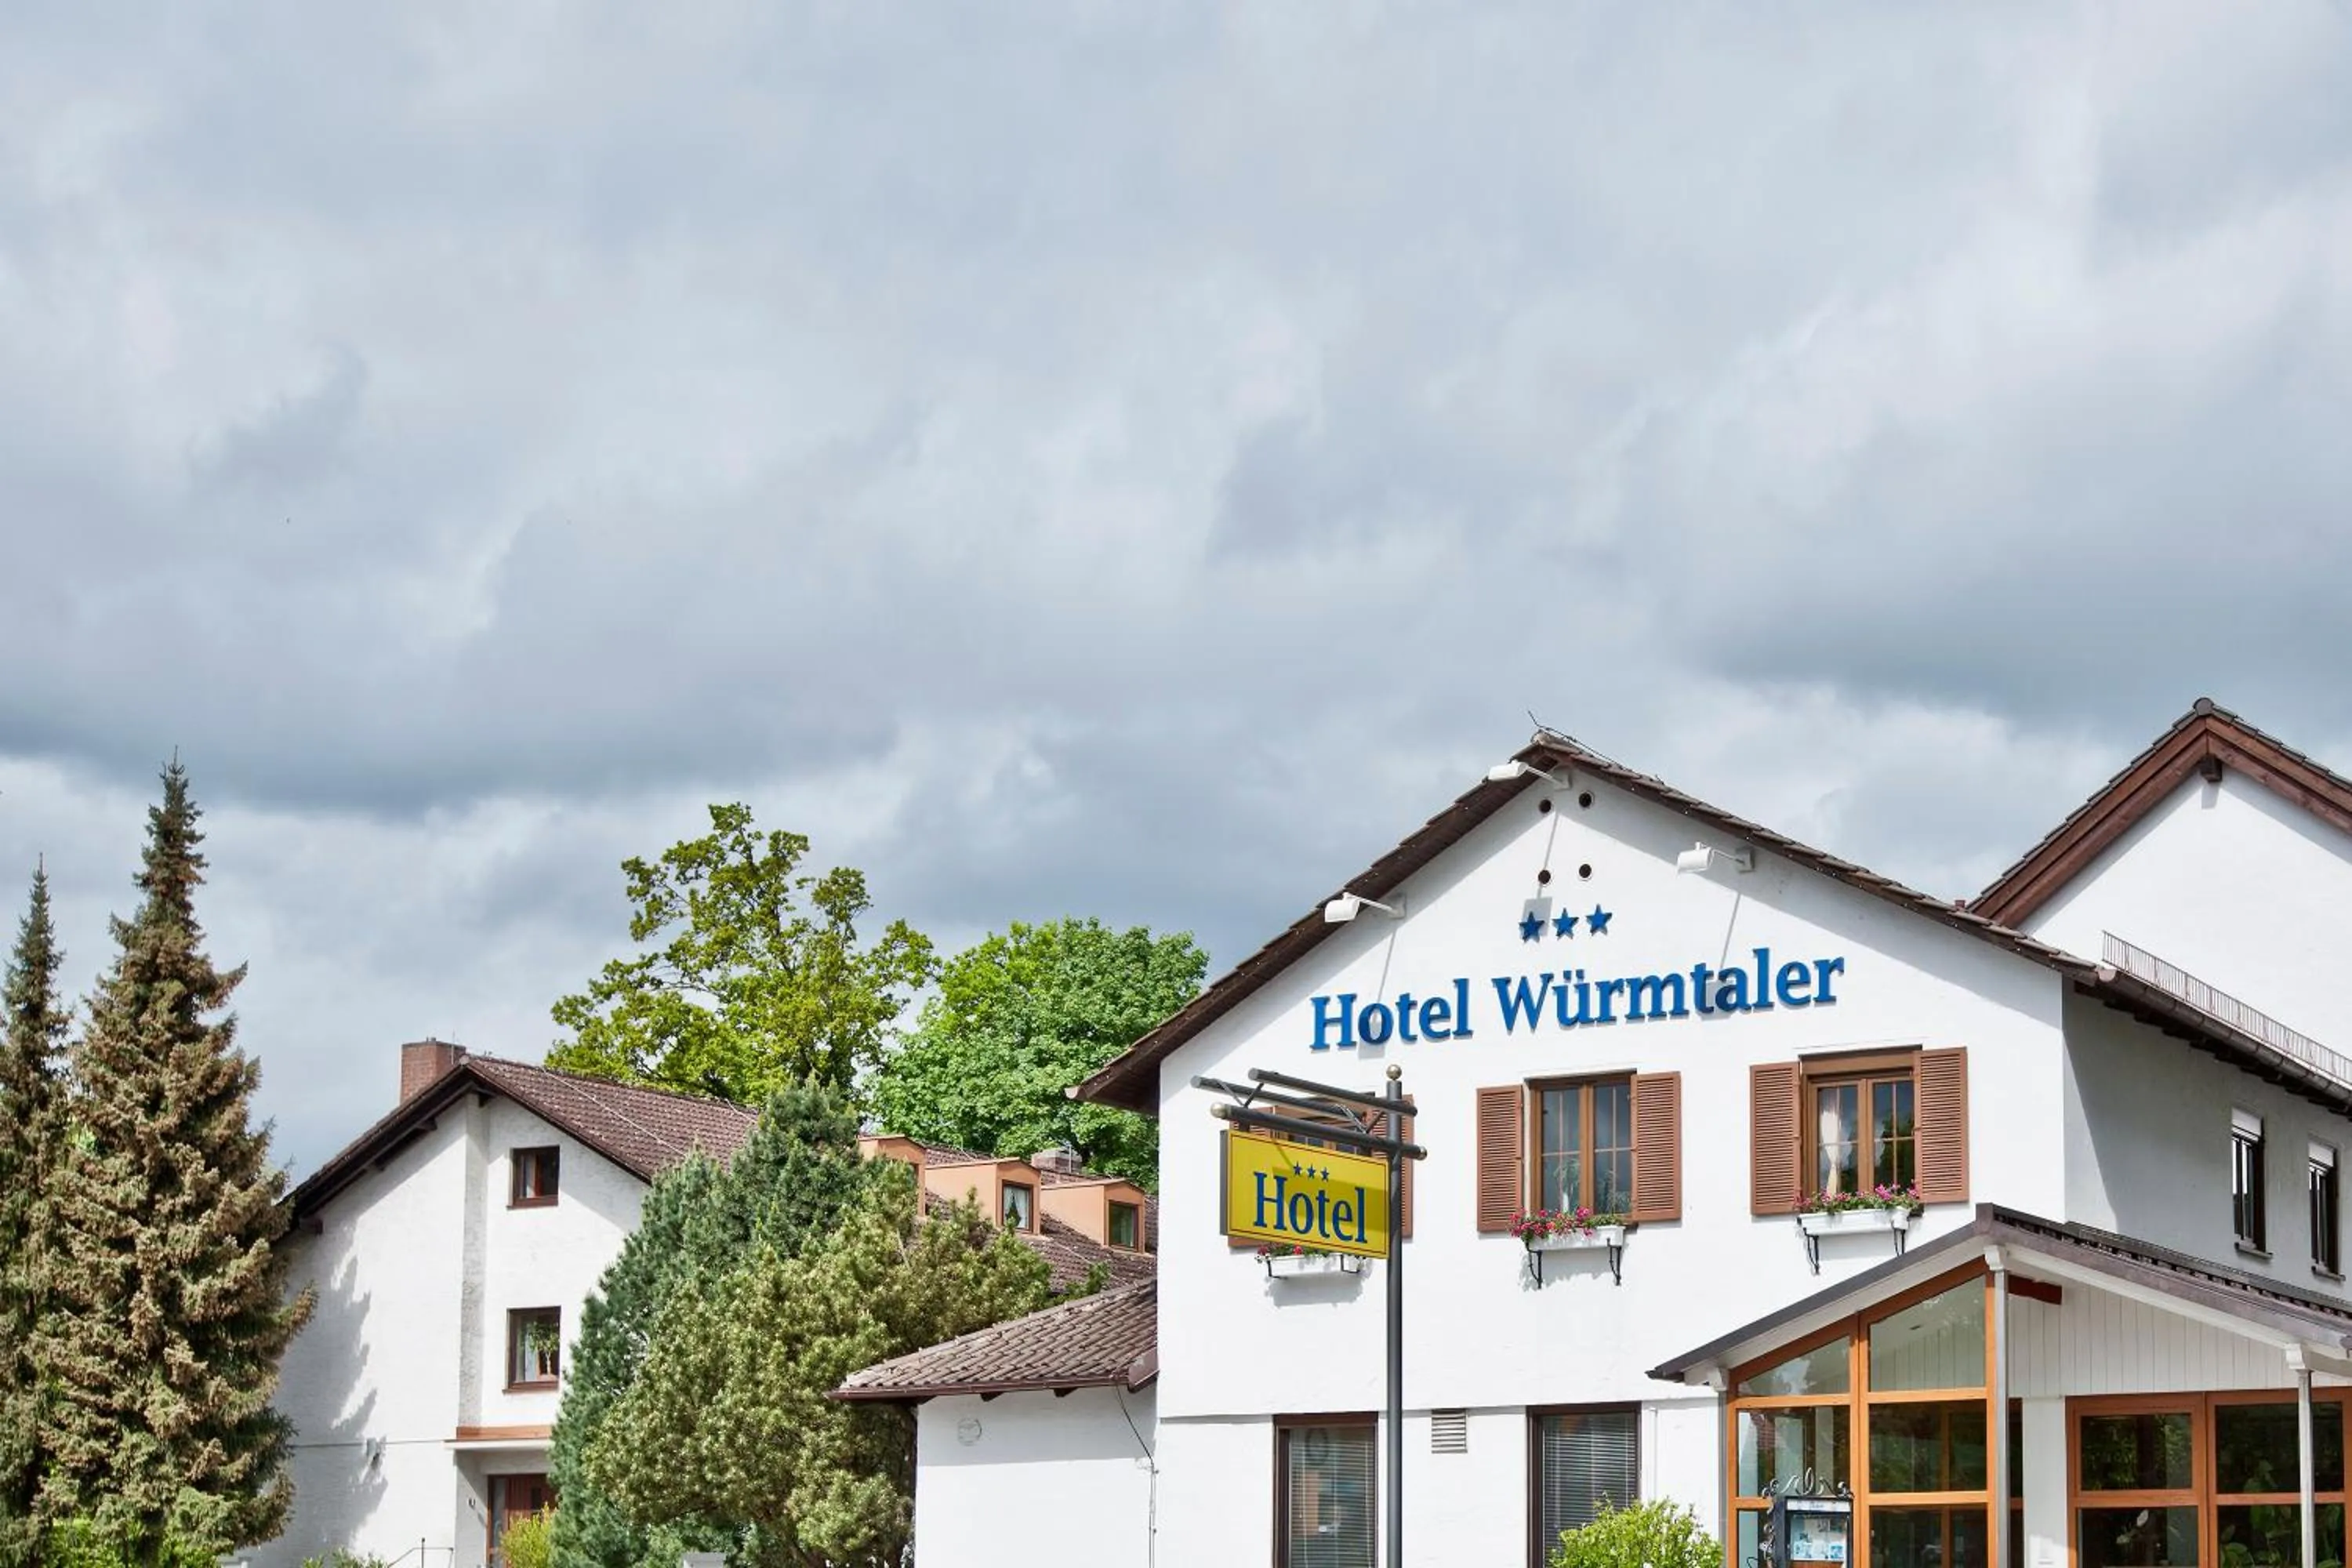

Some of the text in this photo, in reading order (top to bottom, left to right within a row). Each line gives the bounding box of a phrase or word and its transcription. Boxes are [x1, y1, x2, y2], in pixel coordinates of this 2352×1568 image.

[1309, 948, 1844, 1051] Hotel Würmtaler
[1252, 1171, 1367, 1243] Hotel
